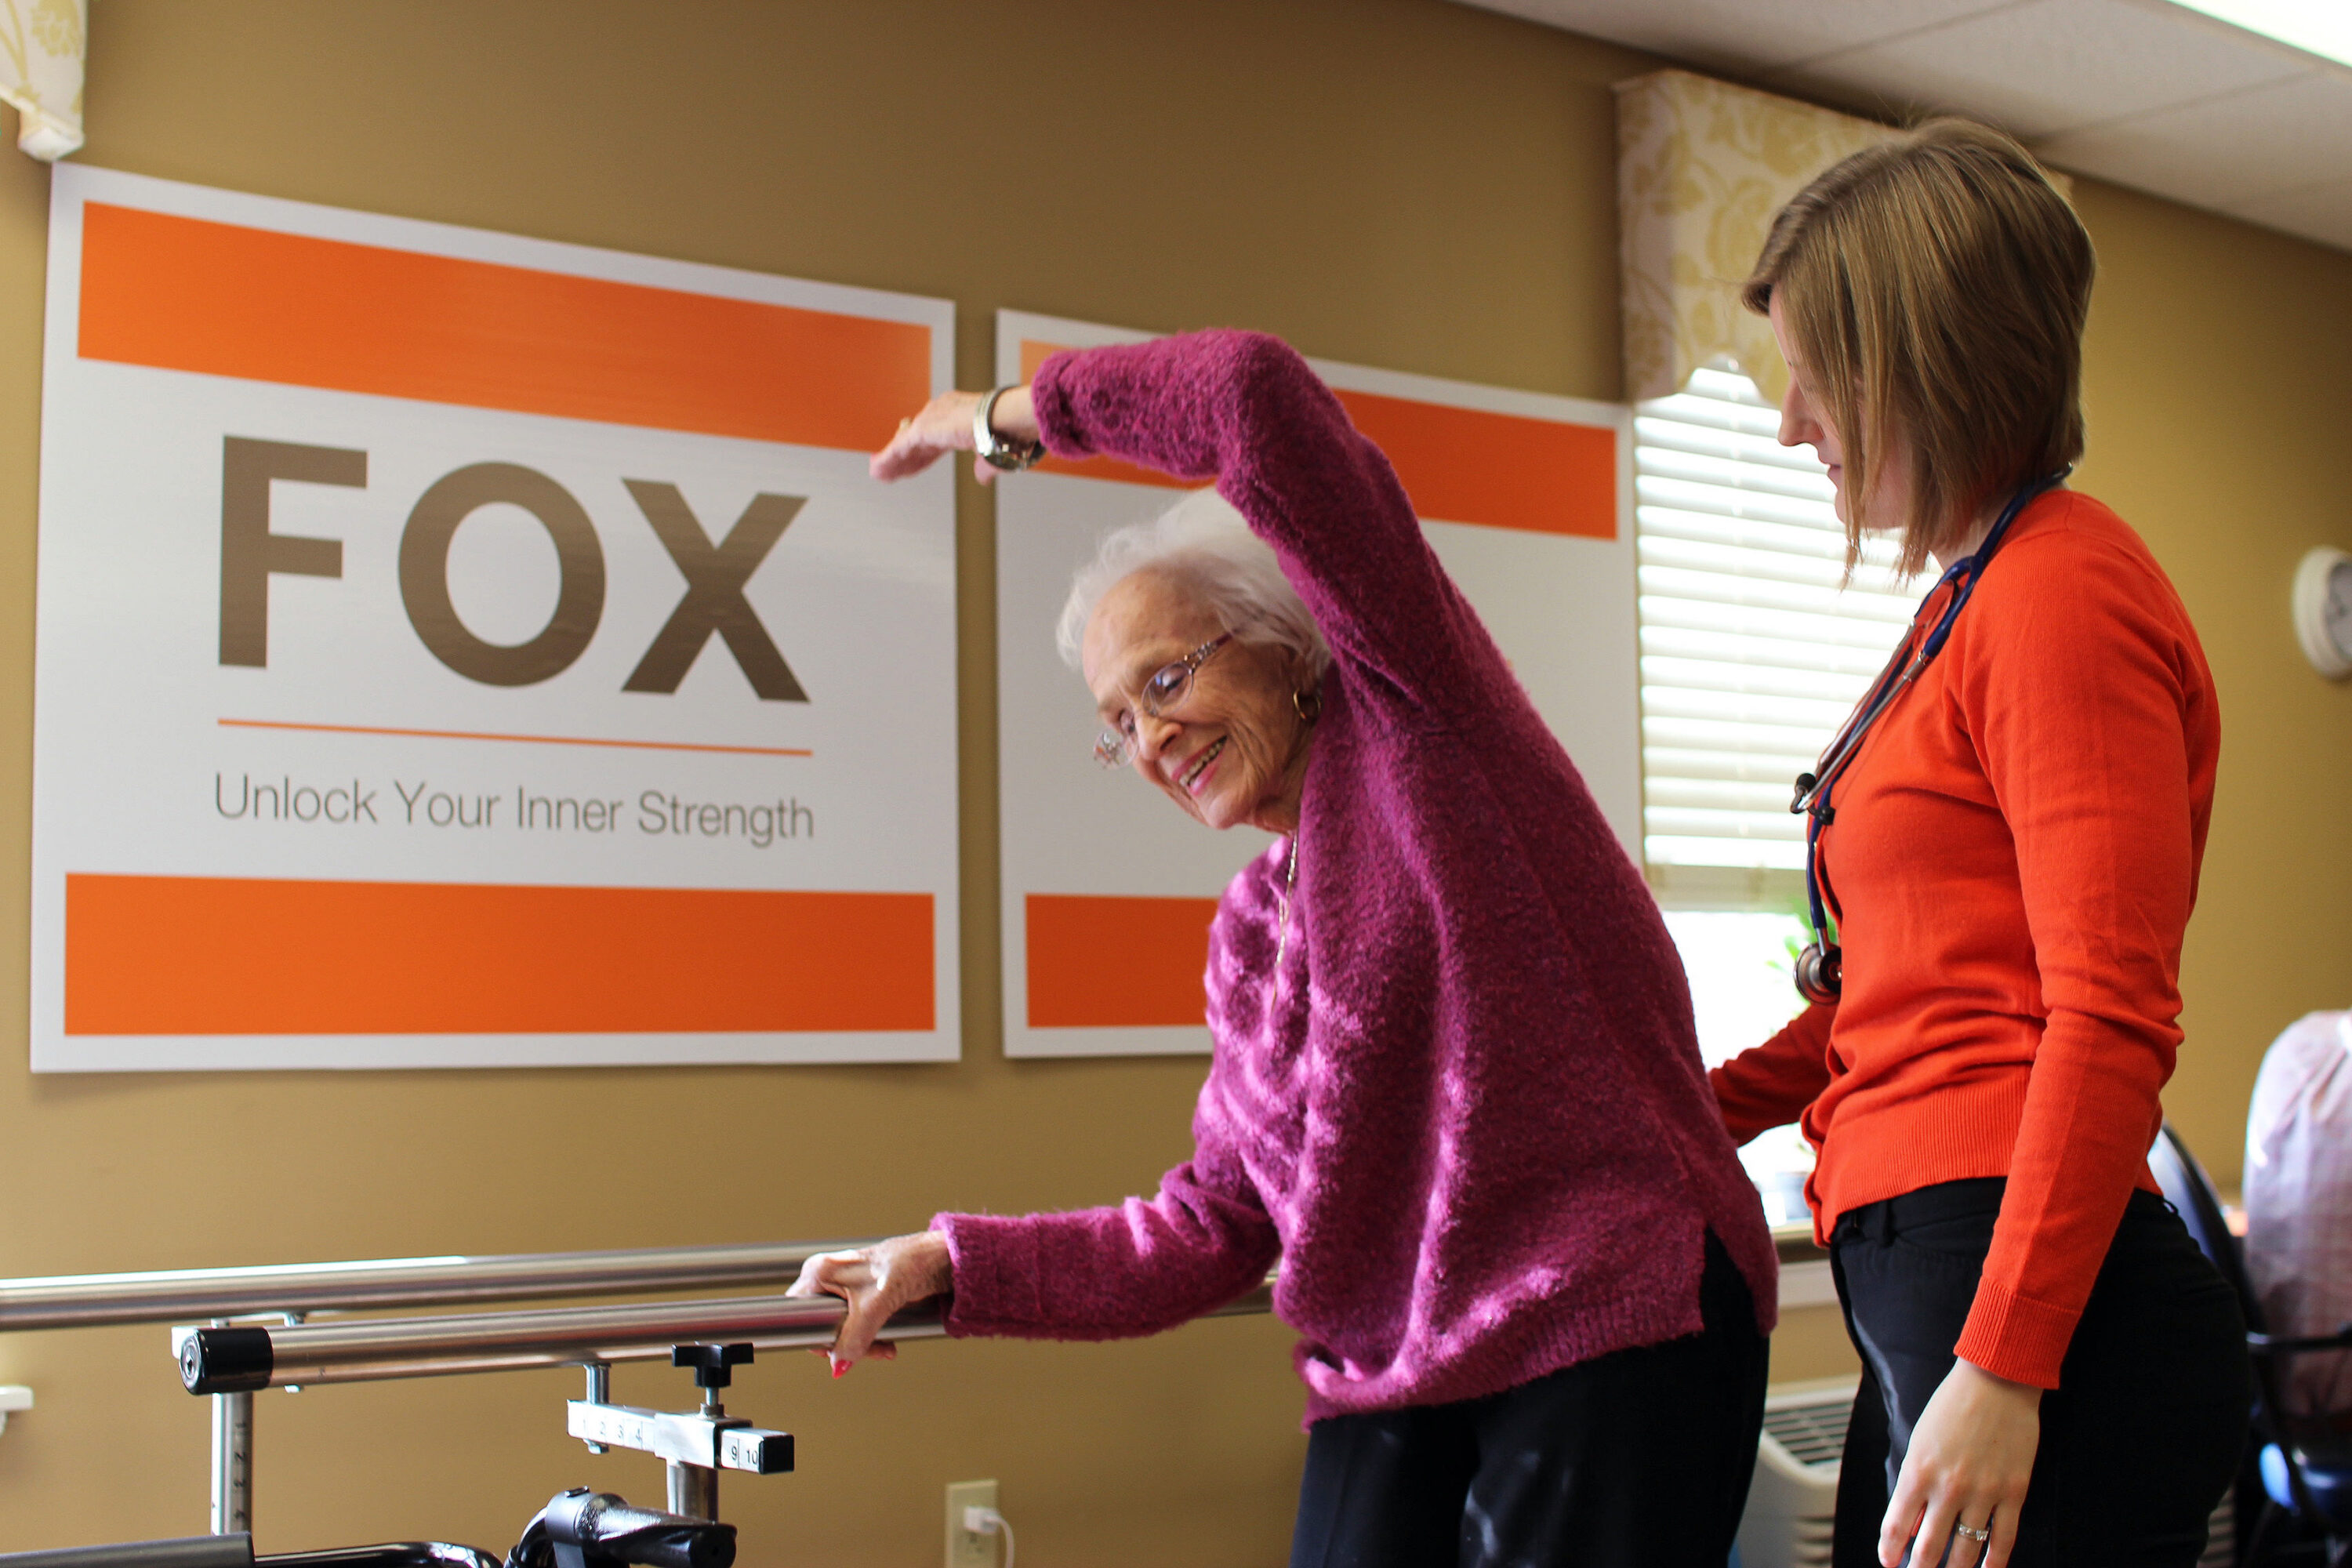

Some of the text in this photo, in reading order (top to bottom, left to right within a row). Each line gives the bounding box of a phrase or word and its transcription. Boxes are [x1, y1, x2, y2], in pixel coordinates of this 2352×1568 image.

[218, 434, 810, 704] FOX
[216, 772, 814, 848] Unlock Your Inner Strength
[731, 1445, 738, 1461] 9
[746, 1449, 758, 1465] 10
